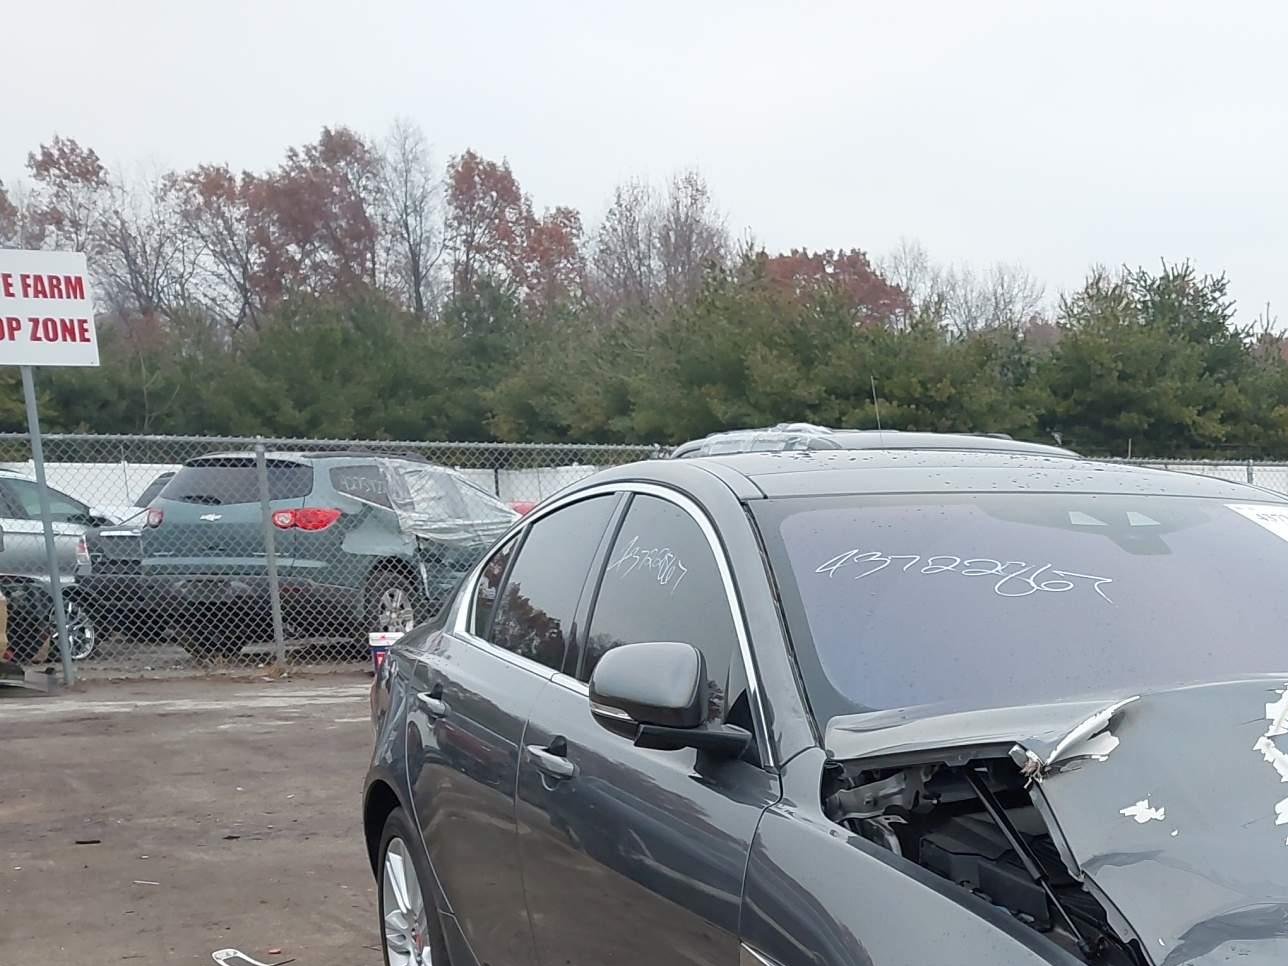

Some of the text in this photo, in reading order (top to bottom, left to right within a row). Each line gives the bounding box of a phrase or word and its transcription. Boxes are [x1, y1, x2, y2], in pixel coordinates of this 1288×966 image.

[20, 273, 86, 300] FARM
[27, 317, 92, 343] ZONE
[815, 548, 1114, 605] 43722867
